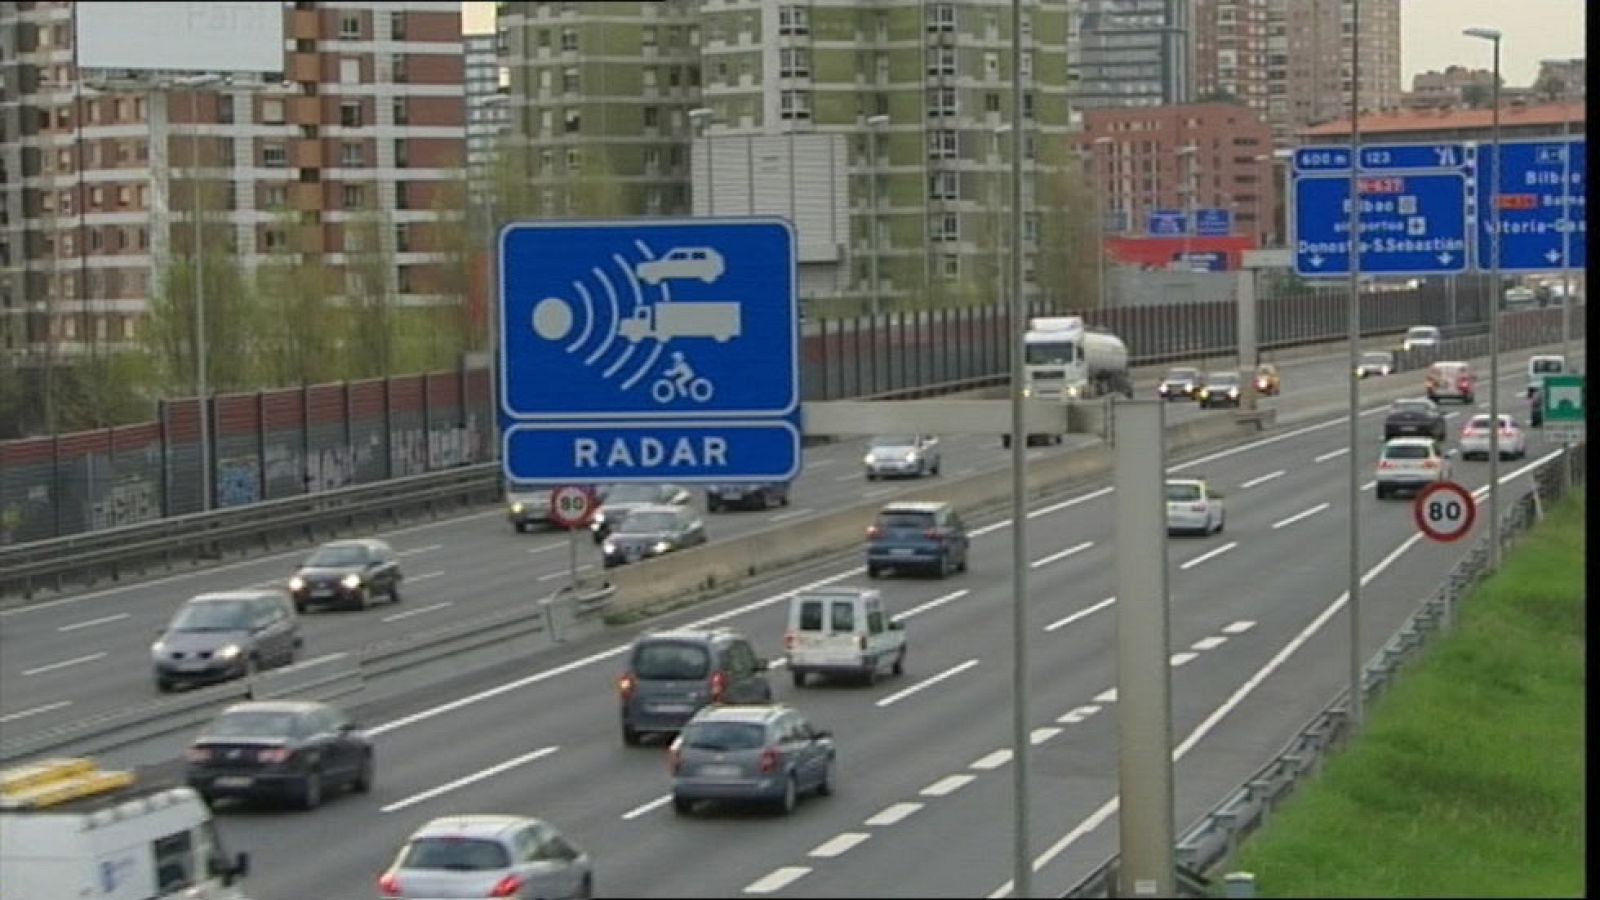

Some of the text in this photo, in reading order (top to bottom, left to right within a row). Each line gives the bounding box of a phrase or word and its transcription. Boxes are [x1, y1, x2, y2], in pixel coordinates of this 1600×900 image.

[1302, 151, 1347, 166] 600 m
[1365, 151, 1391, 166] 123
[1525, 171, 1581, 186] Bilbo
[574, 437, 728, 467] RADAR
[561, 495, 582, 511] 80
[1429, 502, 1461, 521] 80
